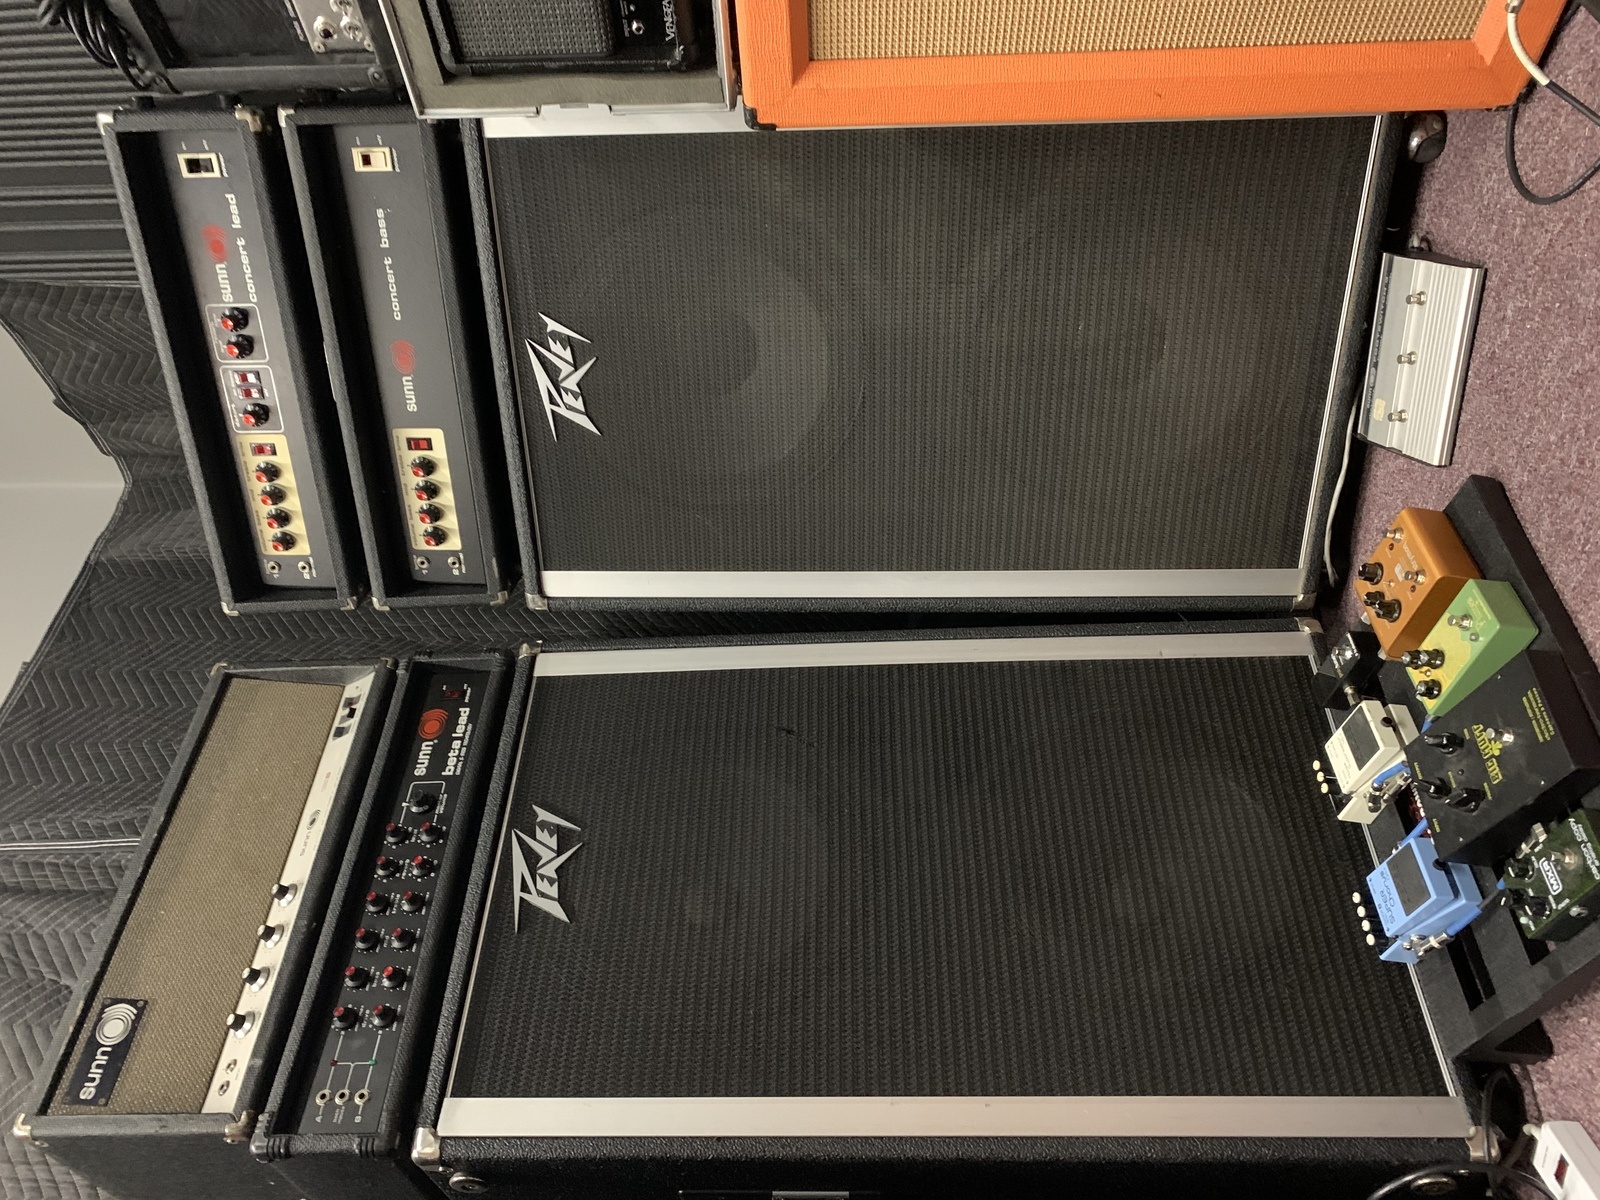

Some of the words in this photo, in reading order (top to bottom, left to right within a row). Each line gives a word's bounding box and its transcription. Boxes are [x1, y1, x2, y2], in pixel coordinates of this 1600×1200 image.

[224, 193, 242, 229] lead
[374, 208, 390, 248] bass
[214, 263, 234, 303] sunn
[235, 236, 257, 303] concert
[382, 256, 401, 321] concert
[401, 376, 417, 413] sunn
[524, 311, 602, 442] PEAVEY
[303, 572, 311, 580] 2
[452, 568, 460, 576] 2
[451, 707, 470, 737] lead
[413, 740, 434, 777] sunn
[441, 740, 462, 776] beta
[1471, 723, 1493, 760] MUFF
[1484, 757, 1503, 785] BIG
[298, 830, 312, 858] sunn
[1567, 818, 1582, 842] copy
[511, 804, 584, 934] PEAVEY
[1541, 859, 1560, 890] MXR
[1580, 843, 1600, 880] carbon
[1379, 869, 1396, 908] Chorus
[1379, 889, 1396, 925] SUPER
[79, 1046, 113, 1100] sunn
[315, 1115, 323, 1123] A
[354, 1115, 362, 1123] B
